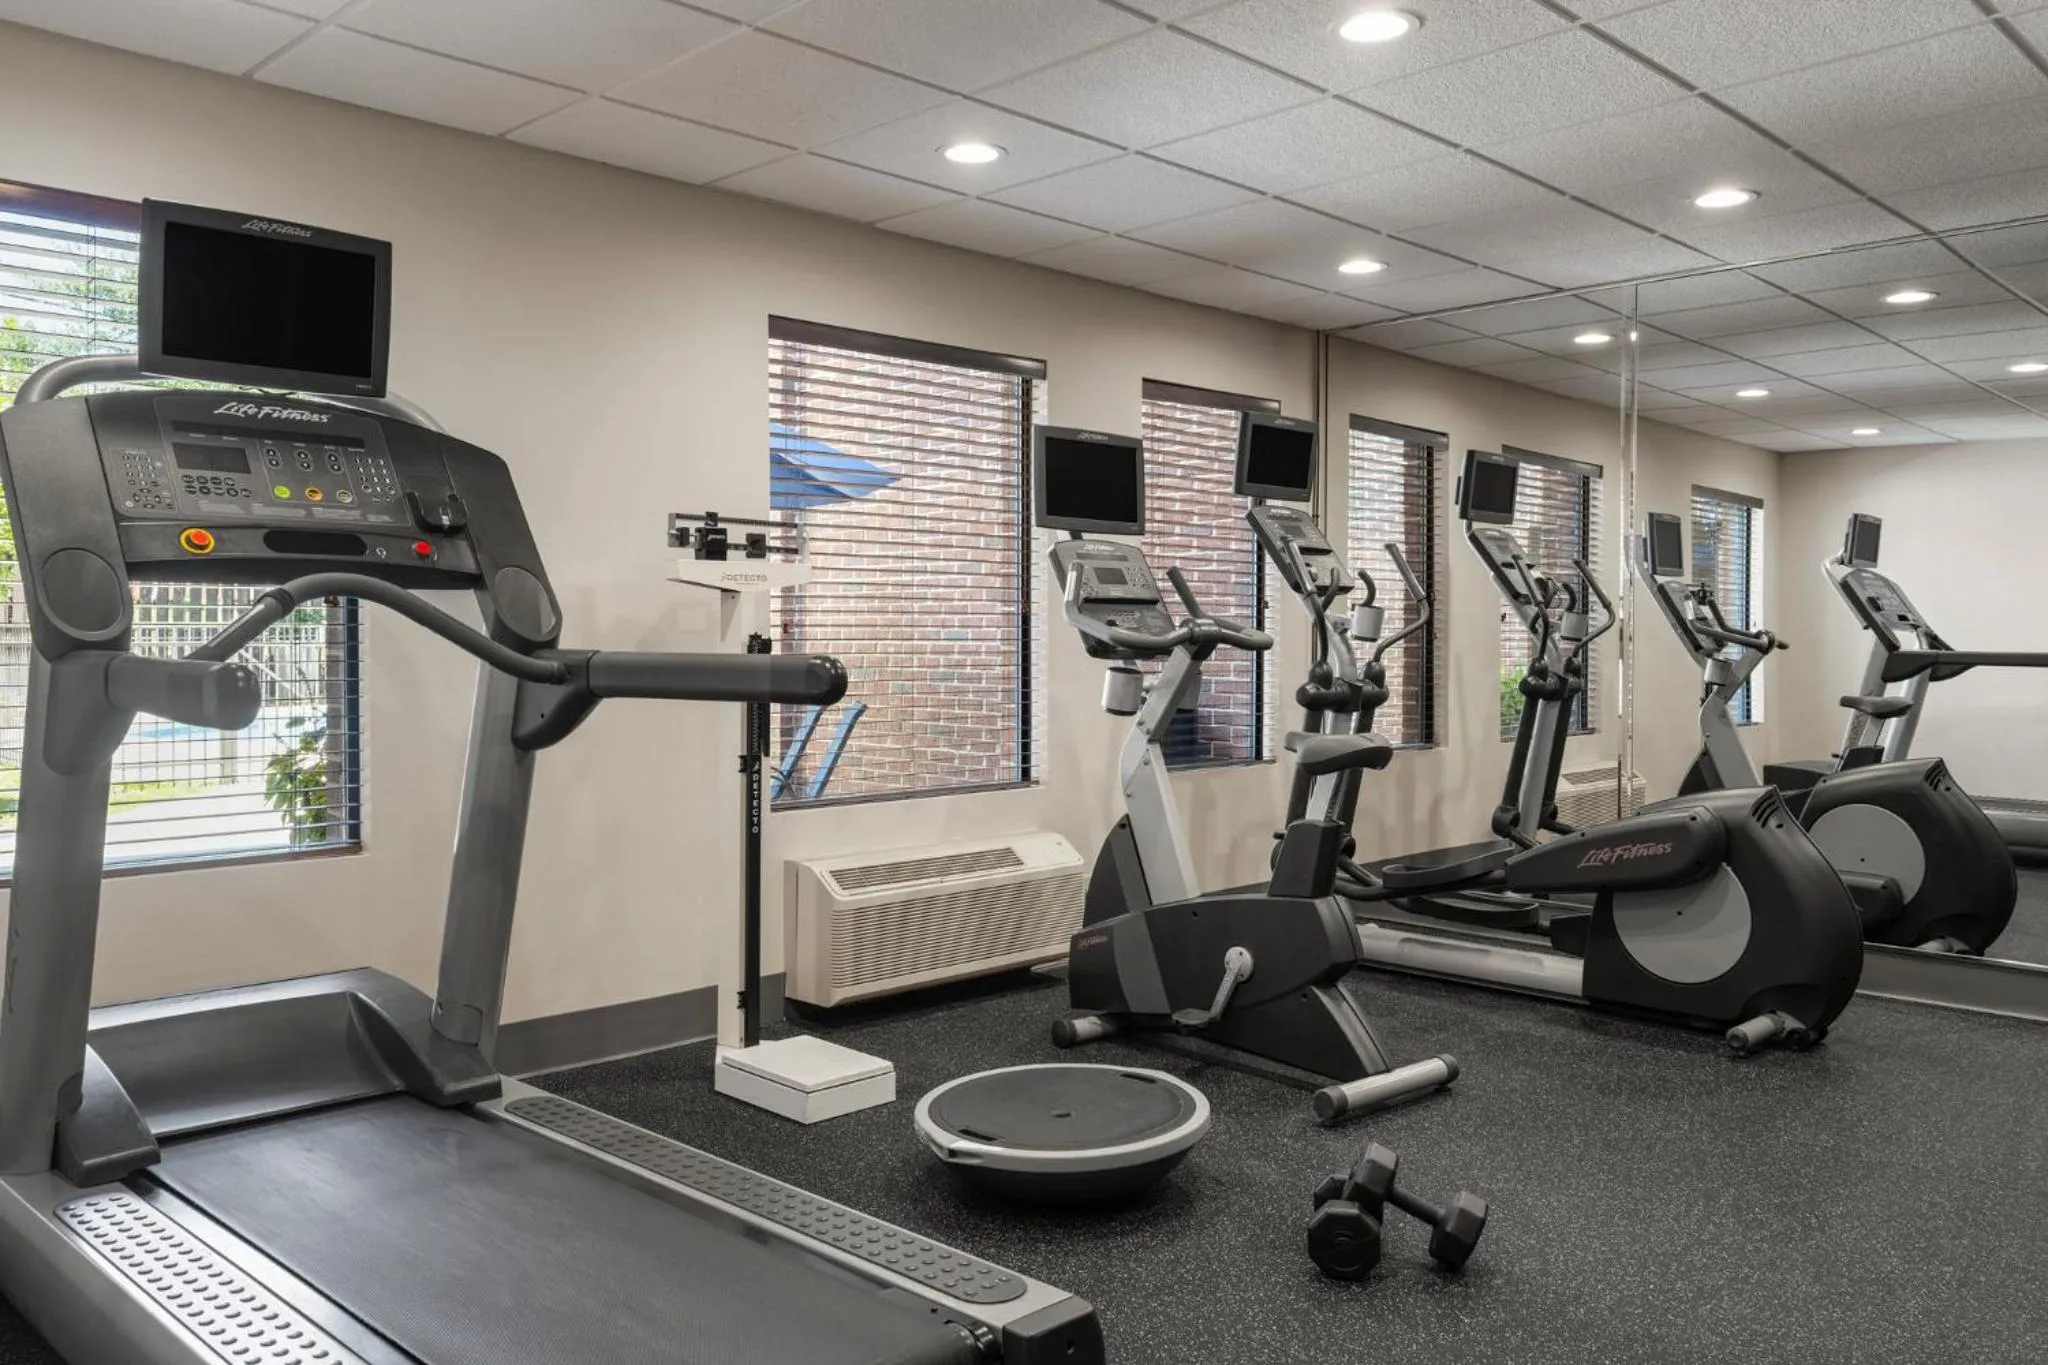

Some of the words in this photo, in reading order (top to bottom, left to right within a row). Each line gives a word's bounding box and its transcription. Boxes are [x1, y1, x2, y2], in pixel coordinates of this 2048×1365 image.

[213, 401, 259, 418] Life
[257, 406, 330, 423] Fitness
[752, 773, 760, 834] DETECTO
[1576, 848, 1612, 869] Life
[1610, 842, 1672, 864] Fitness
